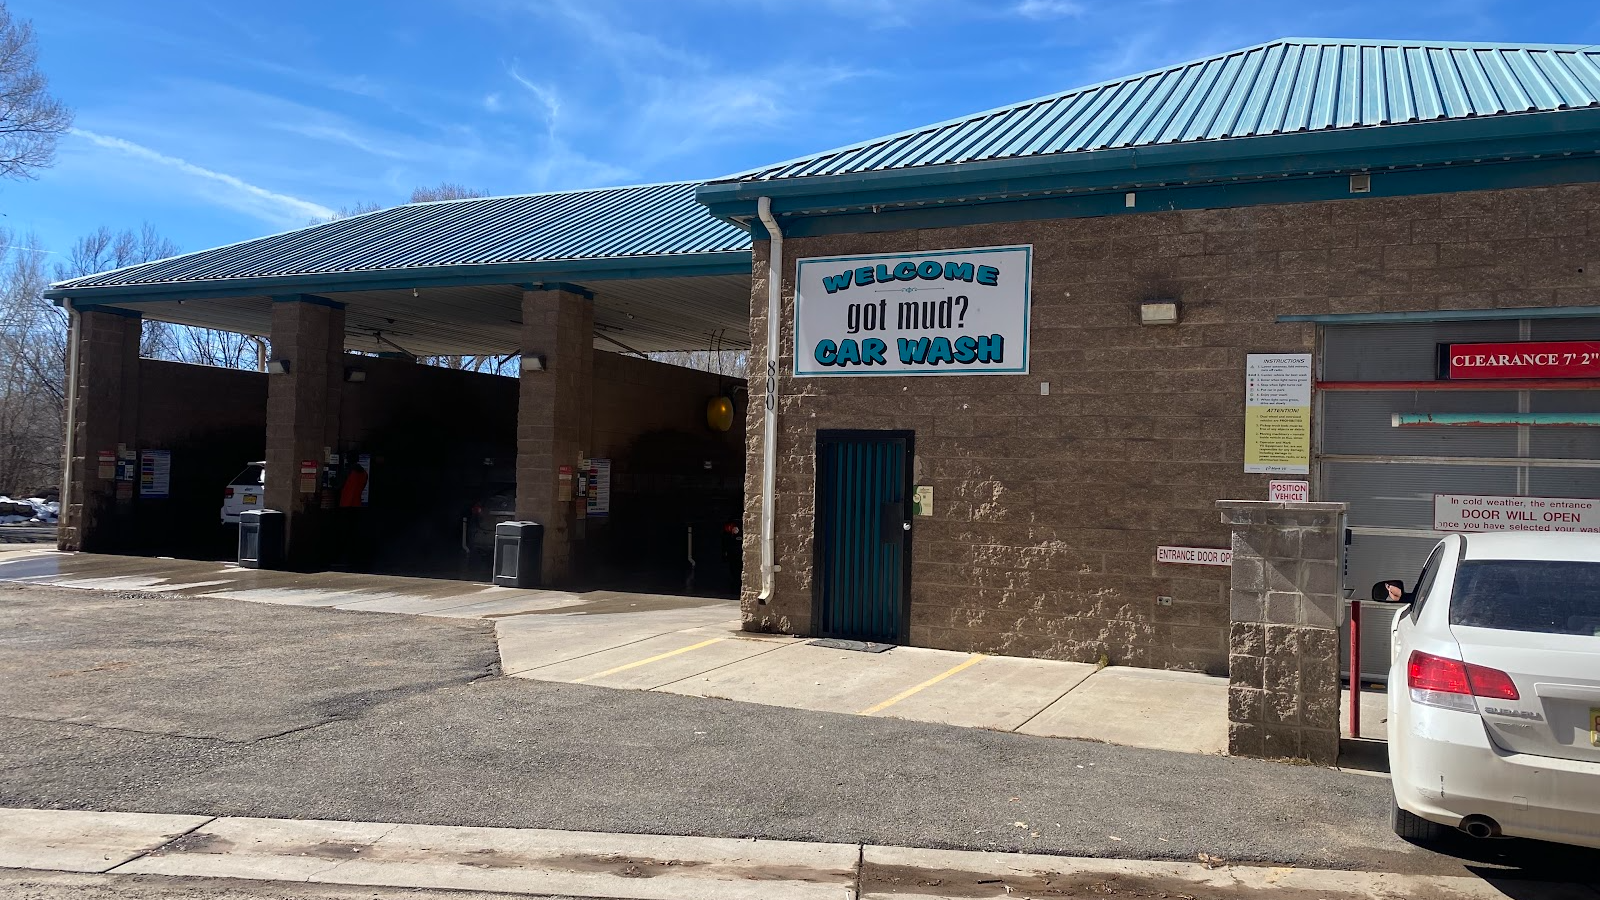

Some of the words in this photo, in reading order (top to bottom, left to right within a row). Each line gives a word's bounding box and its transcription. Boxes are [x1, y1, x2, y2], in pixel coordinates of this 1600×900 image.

[822, 260, 1000, 294] WELCOME
[847, 299, 887, 334] got
[897, 295, 969, 331] mud?
[814, 337, 888, 367] CAR
[896, 333, 1004, 366] WASH
[1452, 353, 1559, 367] CLEARANCE
[1562, 353, 1576, 365] 7'
[1581, 352, 1600, 365] 2"
[766, 360, 776, 410] 800
[1462, 498, 1482, 506] cold
[1486, 499, 1526, 508] weather,
[1549, 501, 1592, 509] entrance
[1462, 509, 1500, 520] DOOR
[1506, 510, 1537, 521] WILL
[1543, 512, 1581, 523] OPEN
[1463, 522, 1480, 531] you
[1483, 522, 1505, 530] have
[1509, 523, 1550, 532] selected
[1159, 549, 1195, 562] ENTRANCE
[1197, 551, 1218, 562] DOOR
[1220, 552, 1232, 563] OP
[1485, 706, 1542, 719] SUBARU
